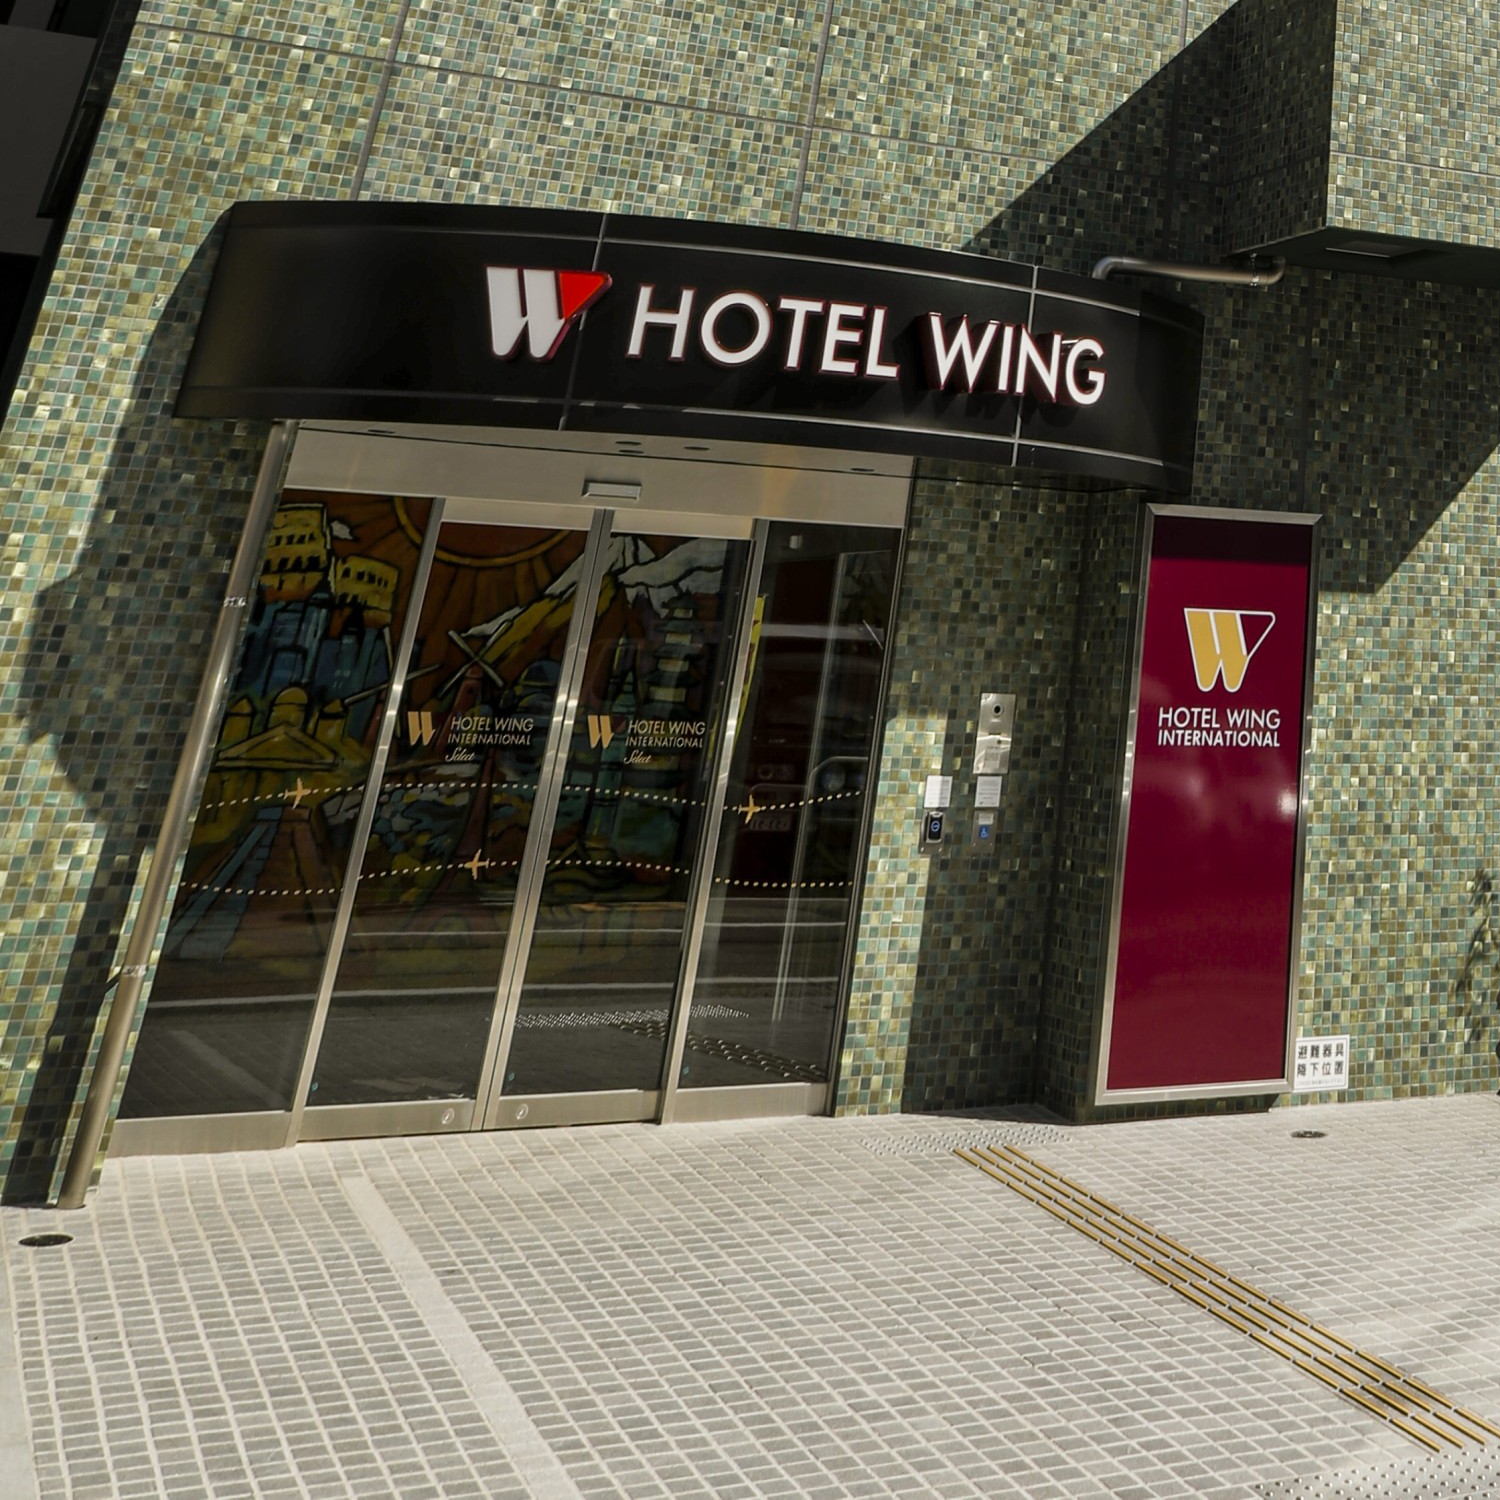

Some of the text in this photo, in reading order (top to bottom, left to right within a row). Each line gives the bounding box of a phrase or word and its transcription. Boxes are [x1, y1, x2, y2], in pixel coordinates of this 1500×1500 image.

[625, 283, 901, 382] HOTEL
[925, 310, 1108, 406] WING
[450, 716, 491, 731] HOTEL
[494, 718, 534, 733] WING
[1158, 706, 1281, 730] HOTEL WING
[627, 719, 666, 735] HOTEL
[668, 721, 706, 736] WING
[447, 732, 531, 746] INTERNATIONAL
[625, 736, 704, 749] INTERNATIONAL
[1157, 729, 1281, 748] INTERNATIONAL
[444, 747, 475, 762] Select
[623, 749, 652, 765] Select
